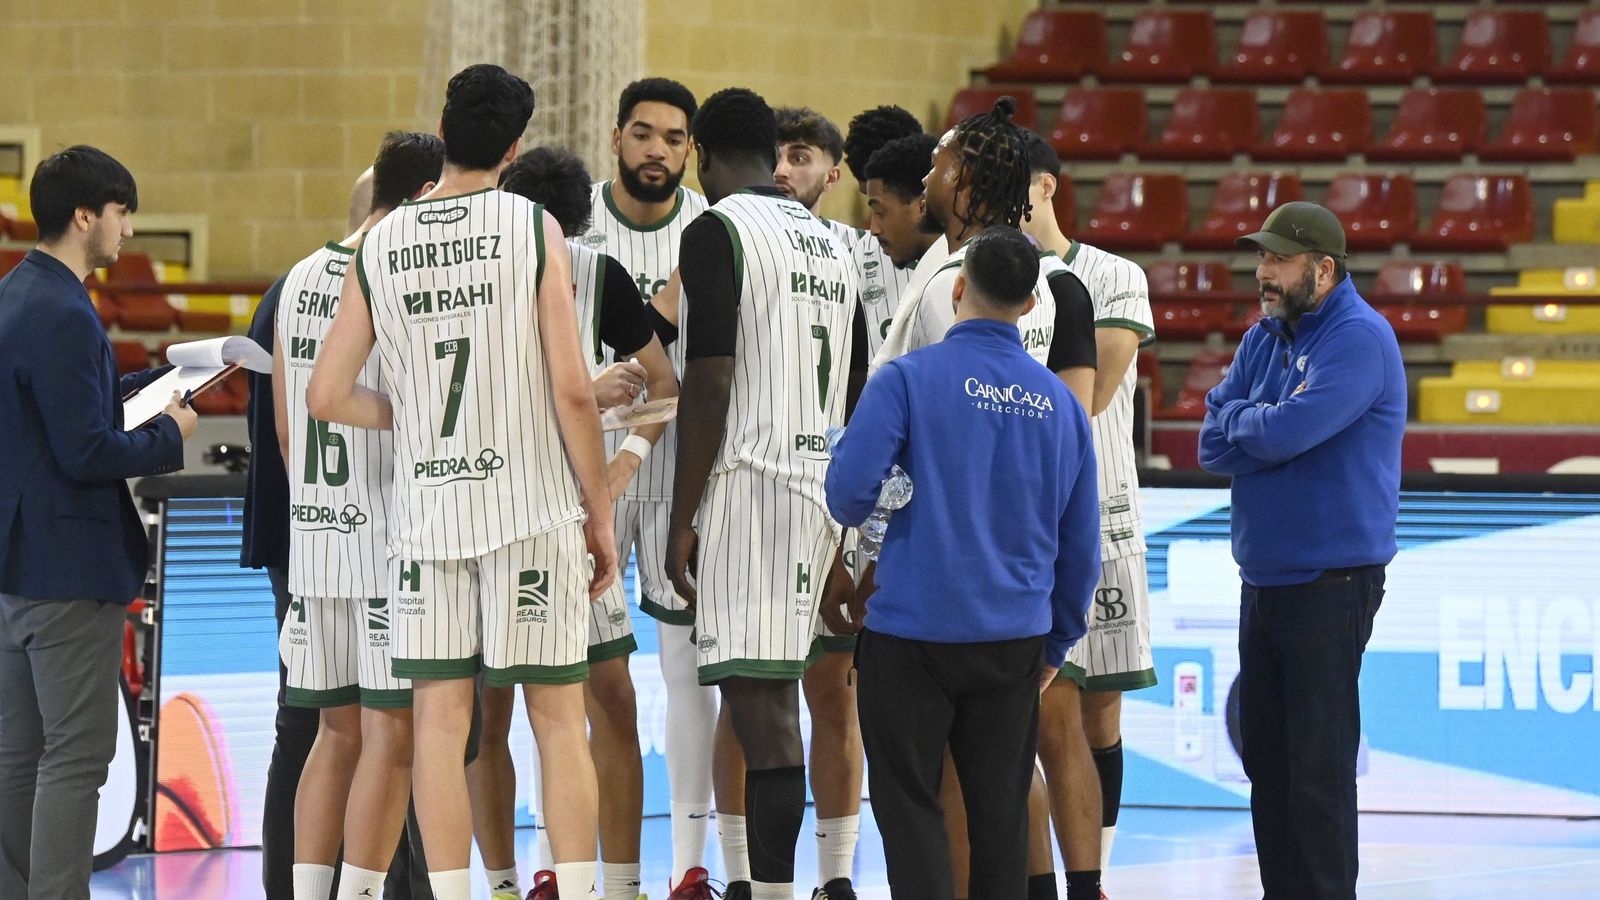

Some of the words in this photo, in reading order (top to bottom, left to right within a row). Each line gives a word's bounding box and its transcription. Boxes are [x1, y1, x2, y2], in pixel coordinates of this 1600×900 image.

[388, 235, 501, 275] RODRIGUEZ
[784, 228, 838, 260] LAMINE
[297, 290, 339, 319] SANC
[437, 283, 493, 312] RAHI
[809, 275, 847, 304] RAHI
[434, 337, 471, 438] 7
[516, 609, 548, 617] REALE
[1438, 595, 1600, 714] ENC
